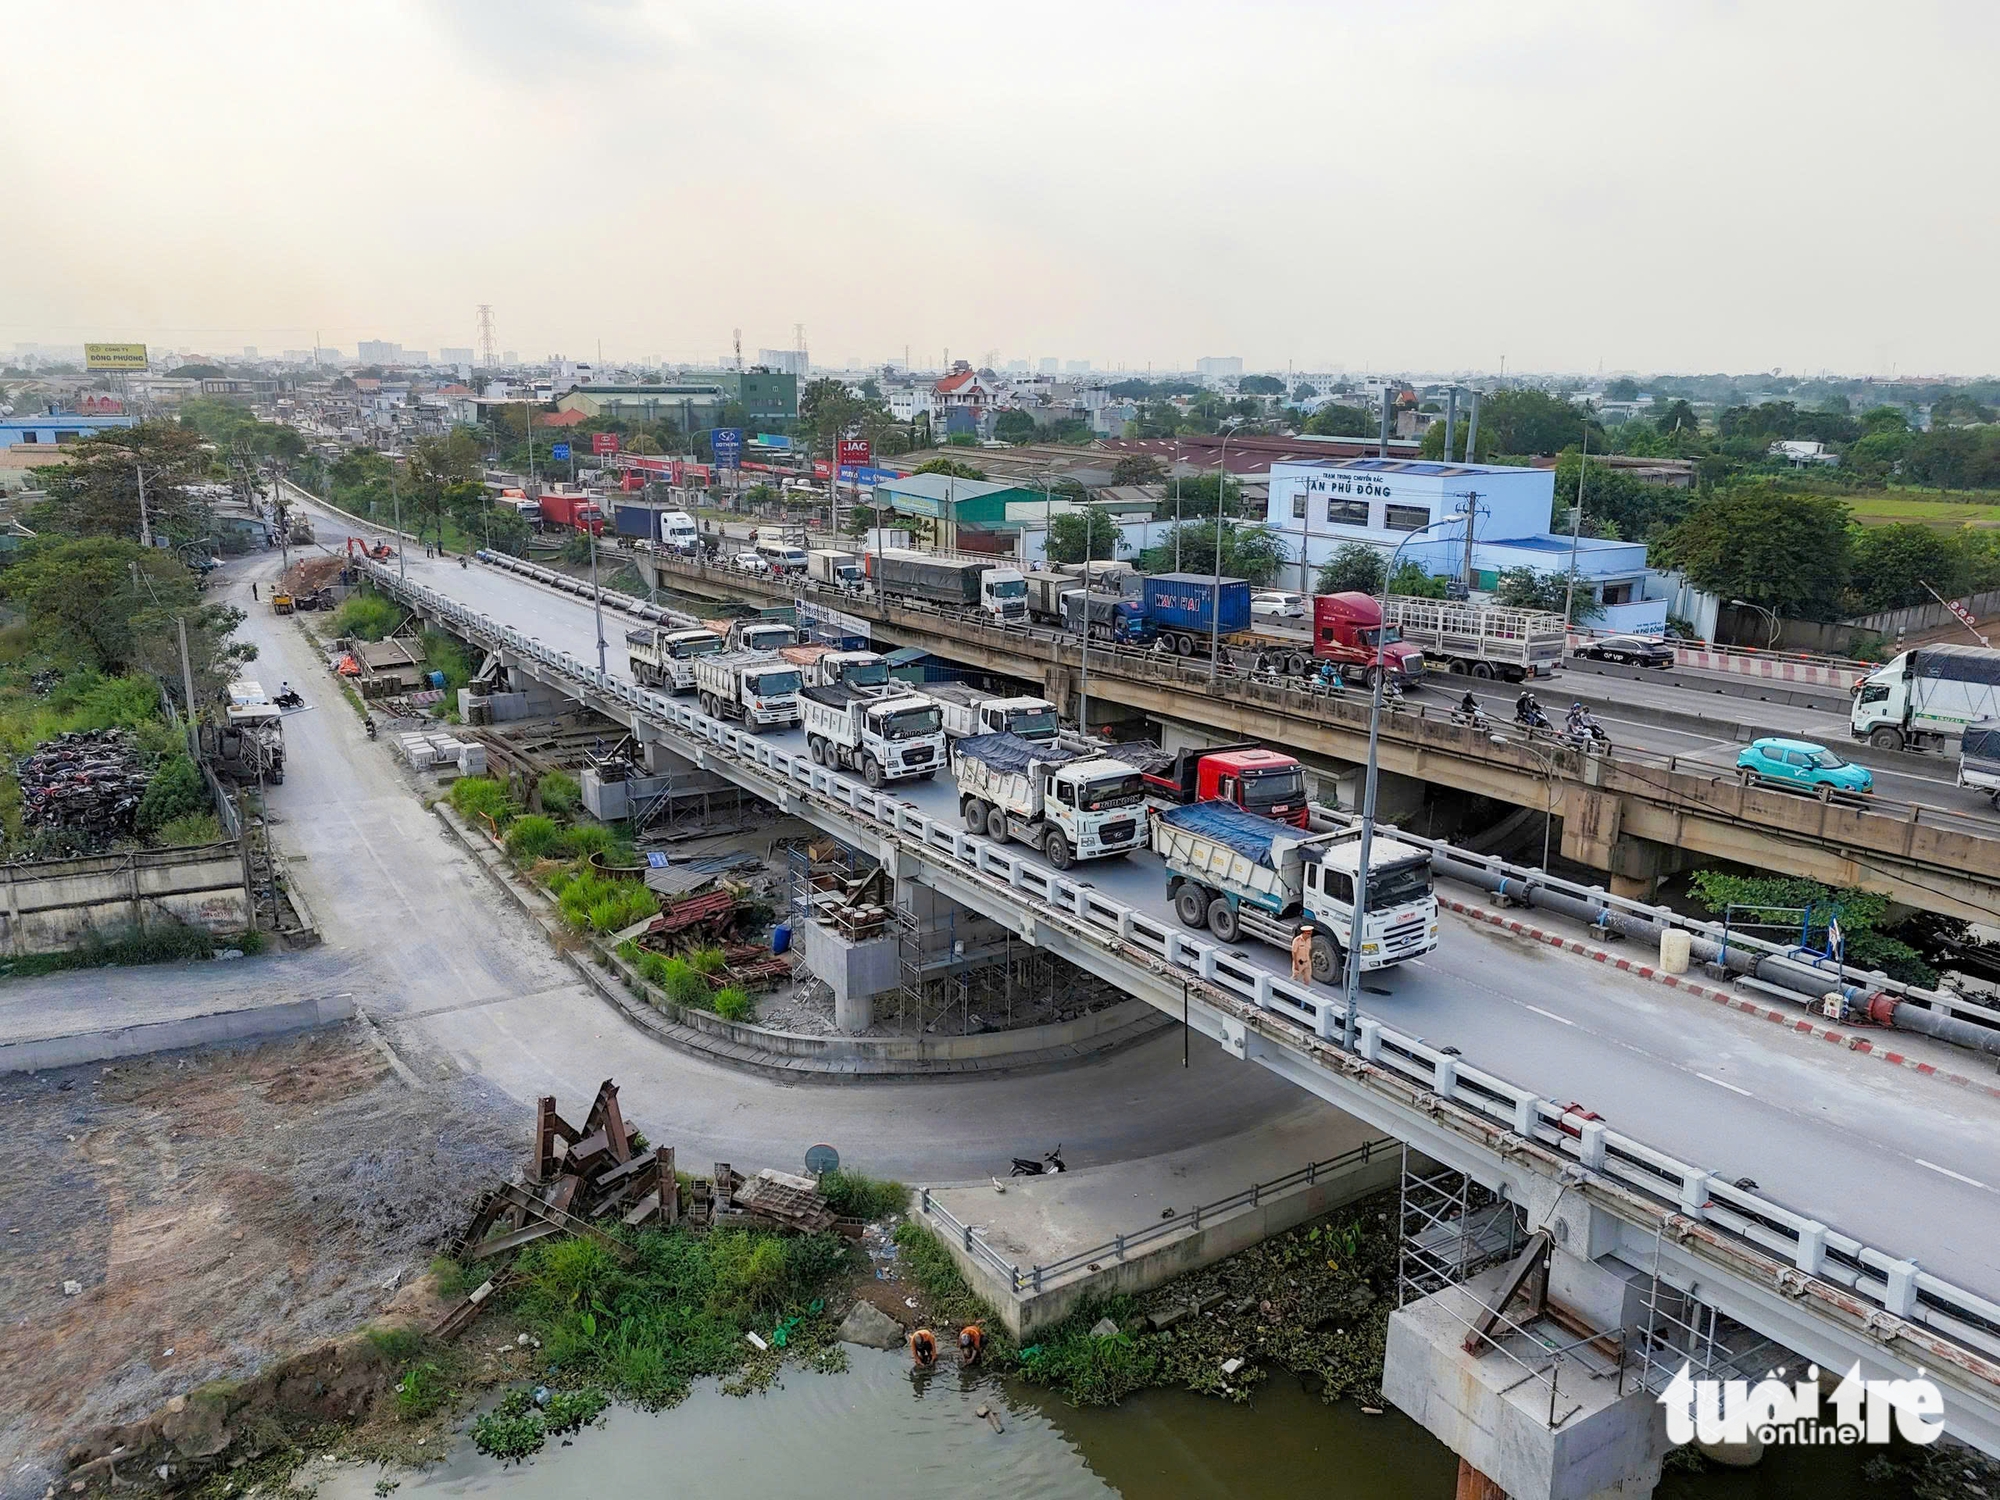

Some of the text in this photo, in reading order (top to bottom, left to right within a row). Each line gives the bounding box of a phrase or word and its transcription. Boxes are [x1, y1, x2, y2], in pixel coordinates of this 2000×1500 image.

[843, 442, 868, 451] JAC
[1311, 480, 1391, 497] AN PHÚ ĐÔNG
[1155, 594, 1200, 612] WAN HAI
